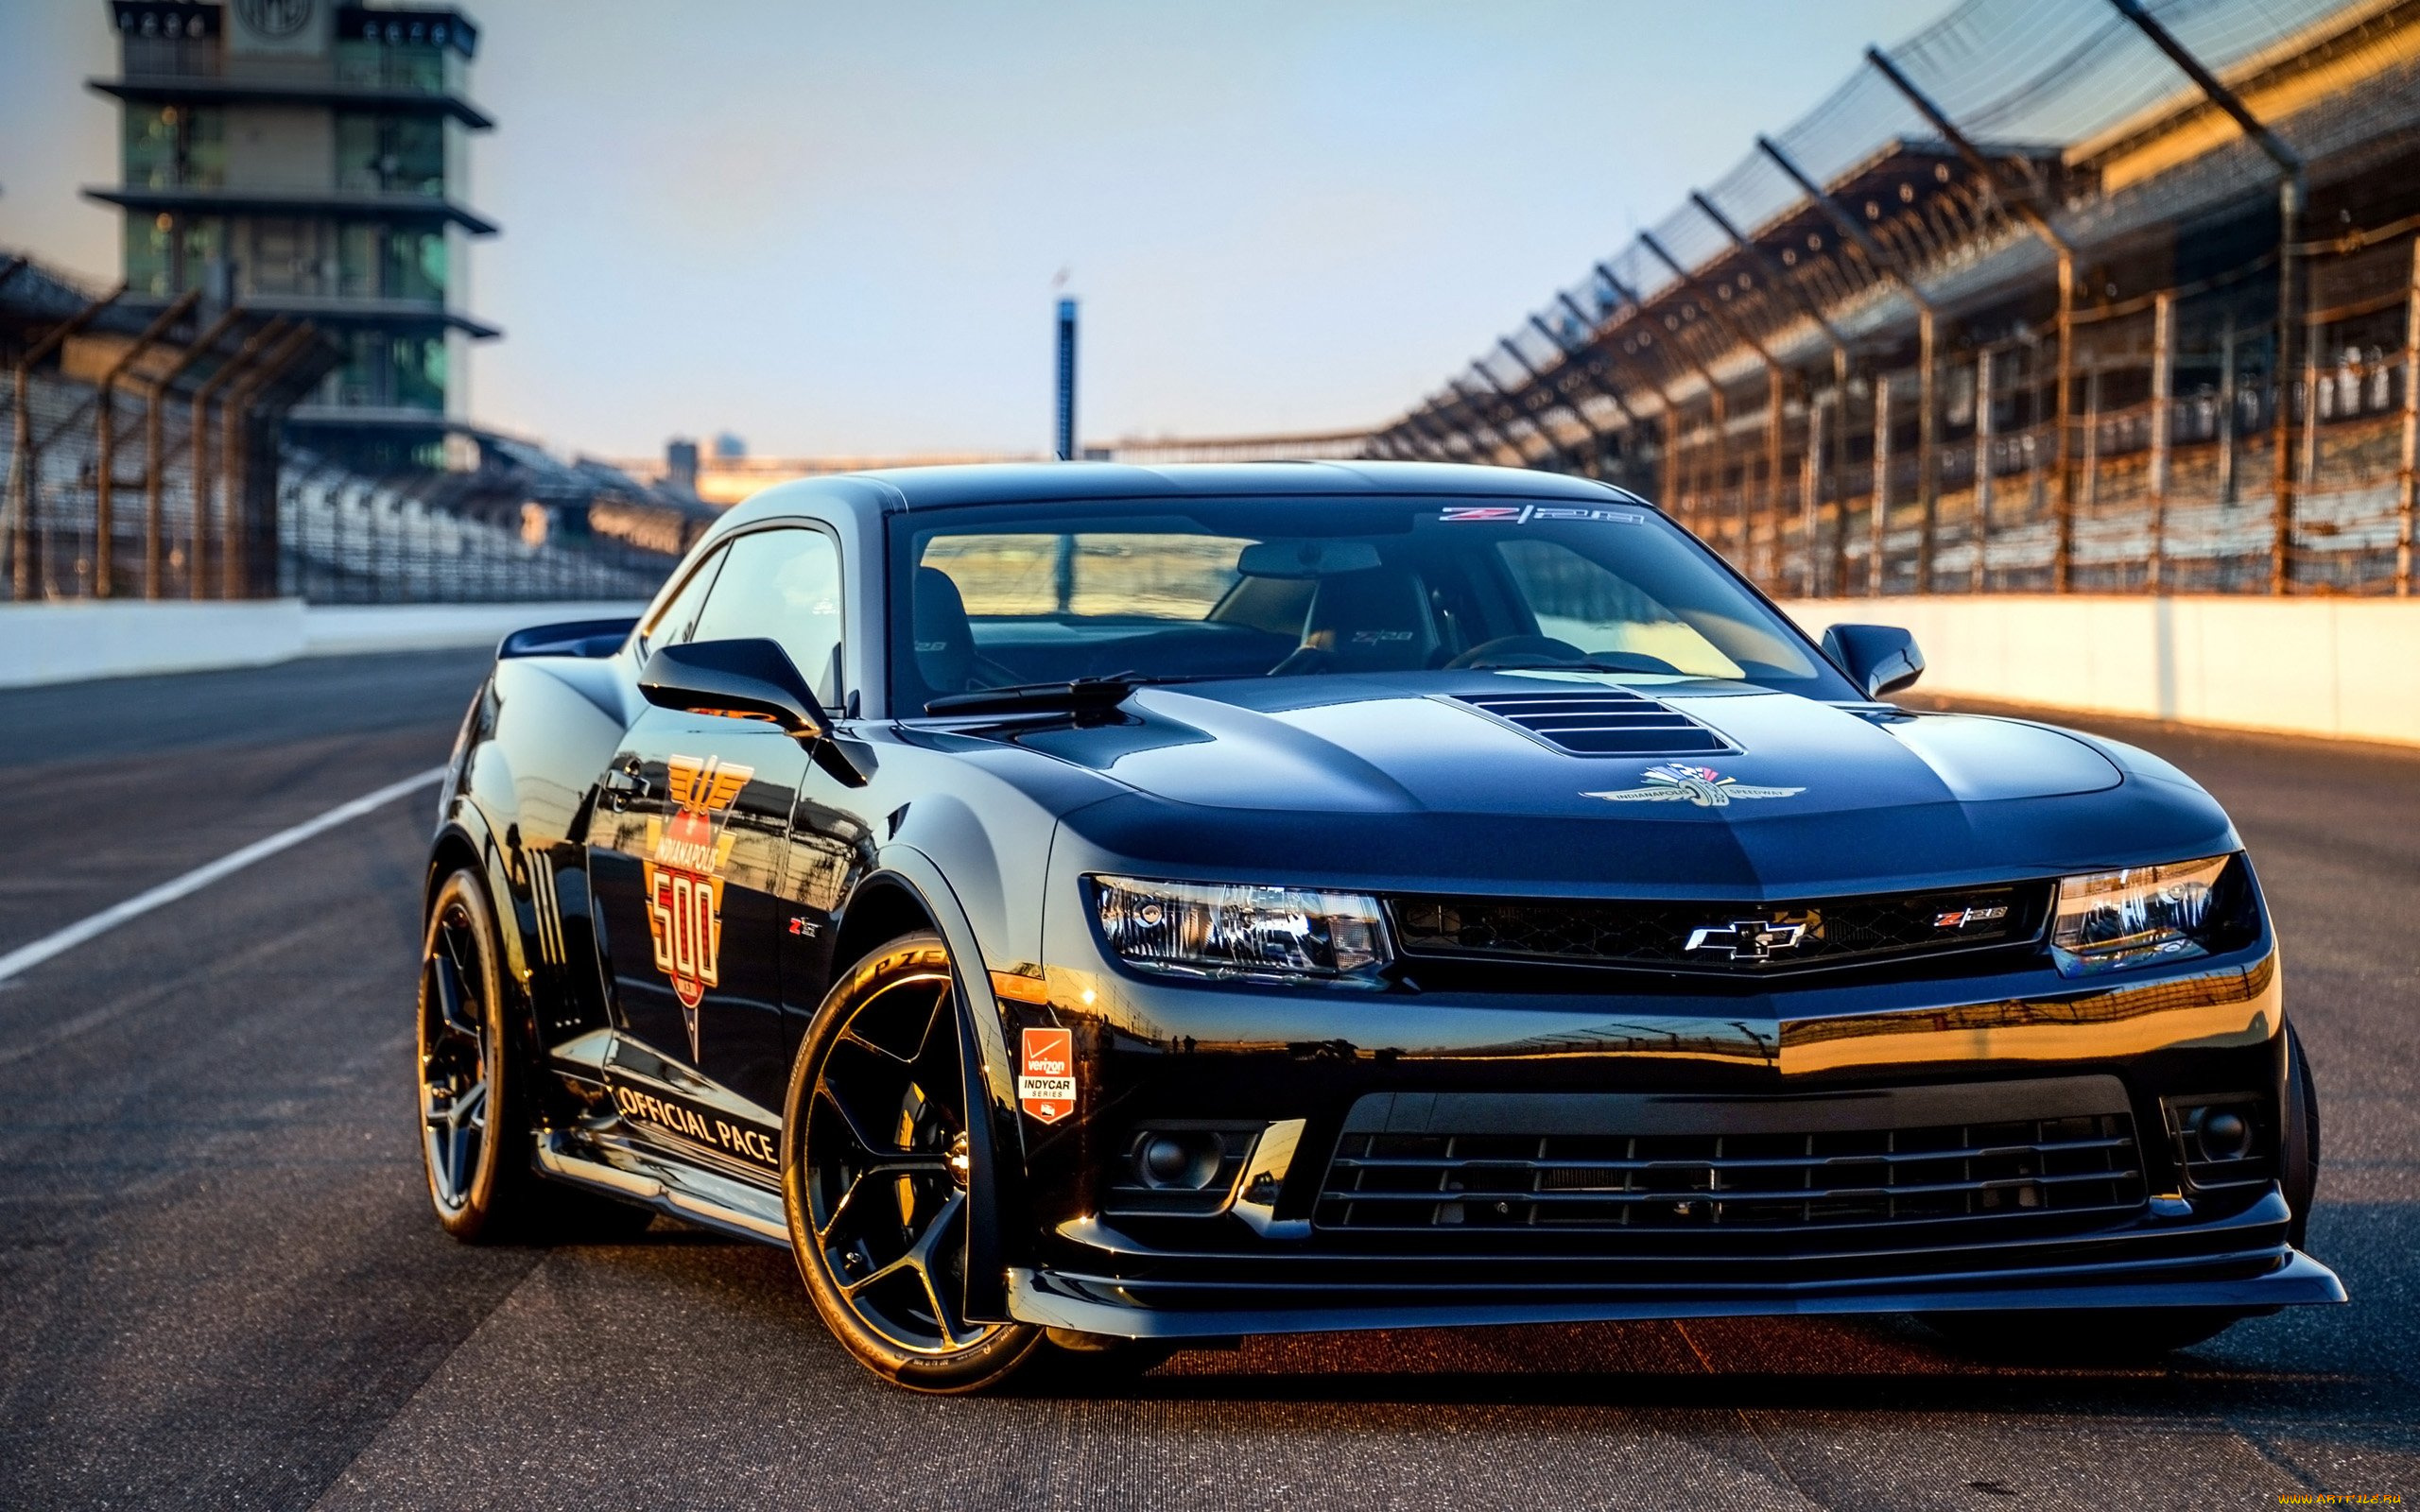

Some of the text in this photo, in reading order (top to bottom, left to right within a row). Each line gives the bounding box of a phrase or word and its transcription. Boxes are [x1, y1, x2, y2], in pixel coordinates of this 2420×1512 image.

[1616, 789, 1689, 800] INDIANAPOLIS
[1729, 788, 1783, 797] SPEEDWAY
[659, 837, 717, 872] INDIANAPOLIS
[653, 871, 718, 985] 500
[1028, 1057, 1064, 1074] verizon
[1025, 1079, 1070, 1090] INDYCAR
[619, 1087, 778, 1165] OFFICIAL PACE
